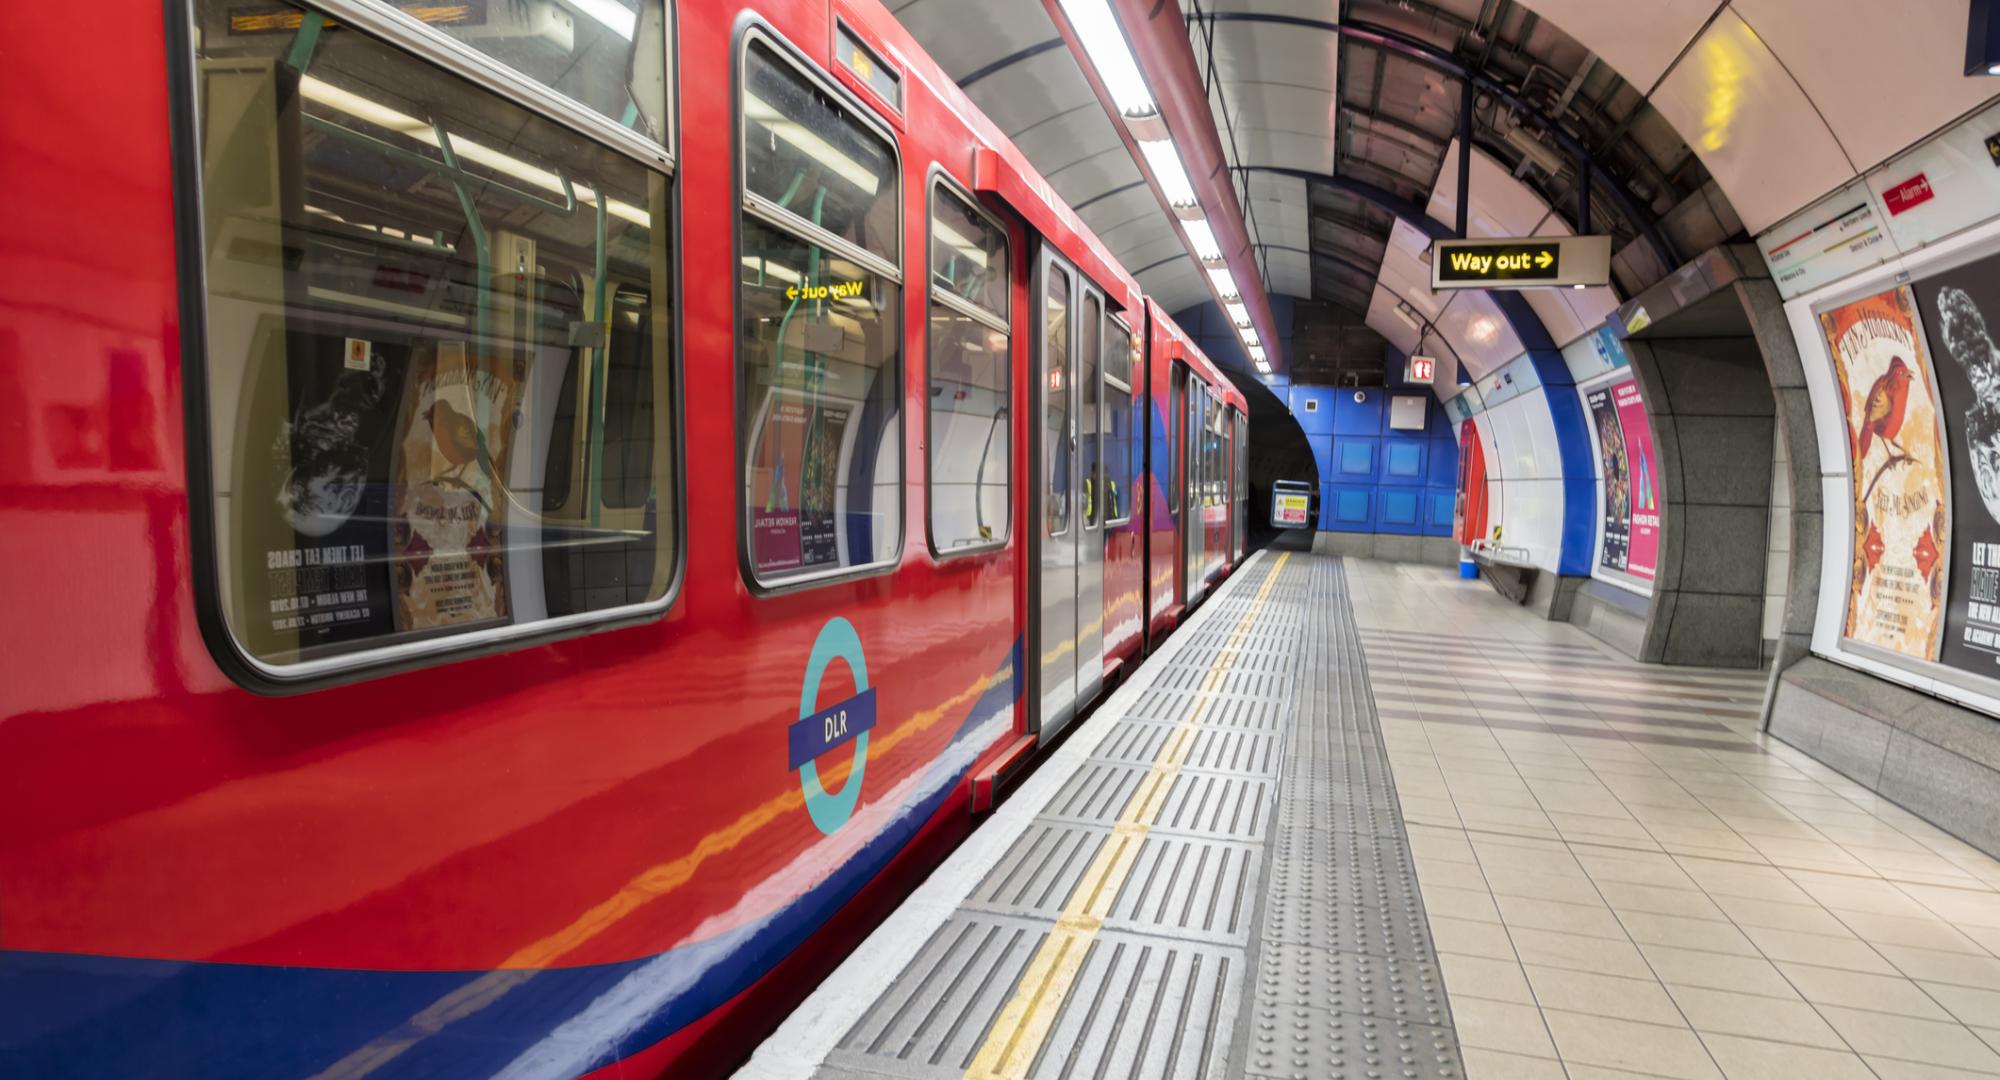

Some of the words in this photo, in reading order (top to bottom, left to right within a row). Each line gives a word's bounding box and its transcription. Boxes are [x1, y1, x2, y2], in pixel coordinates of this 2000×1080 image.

[1900, 182, 1922, 202] Alarm
[1450, 252, 1492, 274] Way
[1496, 252, 1531, 270] out
[1972, 542, 1985, 565] LET
[824, 710, 848, 744] DLR
